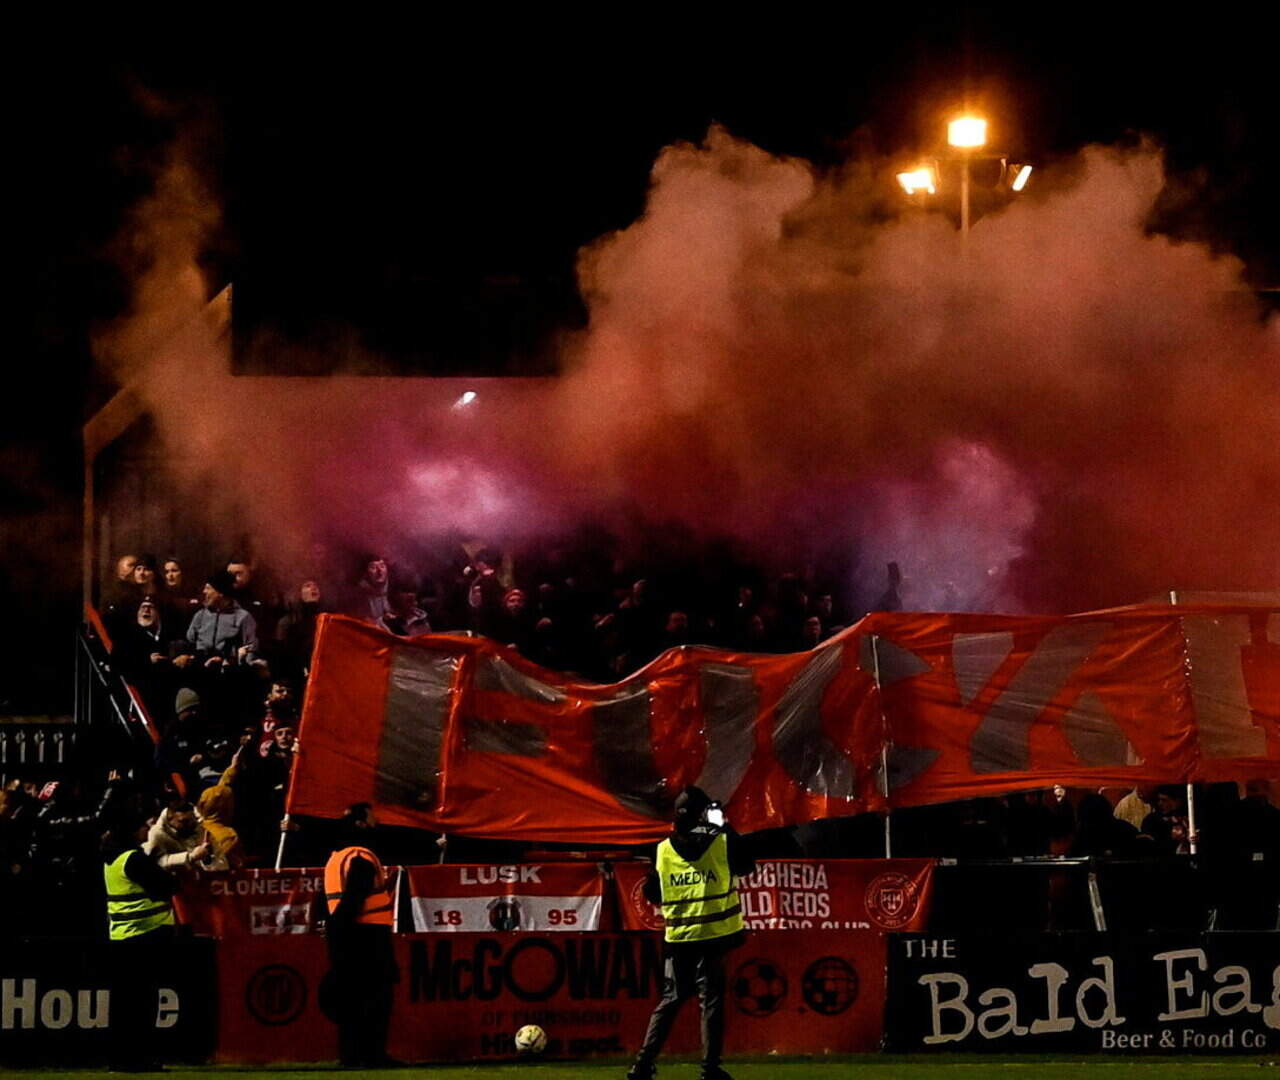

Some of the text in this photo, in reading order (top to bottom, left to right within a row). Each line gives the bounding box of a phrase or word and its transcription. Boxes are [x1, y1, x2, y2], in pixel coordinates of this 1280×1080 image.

[374, 622, 1147, 813] FUCK
[459, 865, 542, 886] LUSK
[670, 870, 717, 886] MEDIA
[732, 862, 829, 889] ROGHEDA
[211, 878, 294, 896] CLONEE
[779, 891, 830, 919] REDS
[433, 910, 462, 926] 18
[547, 909, 577, 925] 95
[904, 939, 957, 959] THE
[2, 978, 180, 1030] Houe
[918, 956, 1126, 1044] Bald
[1102, 1028, 1267, 1049] Beer & Food Co
